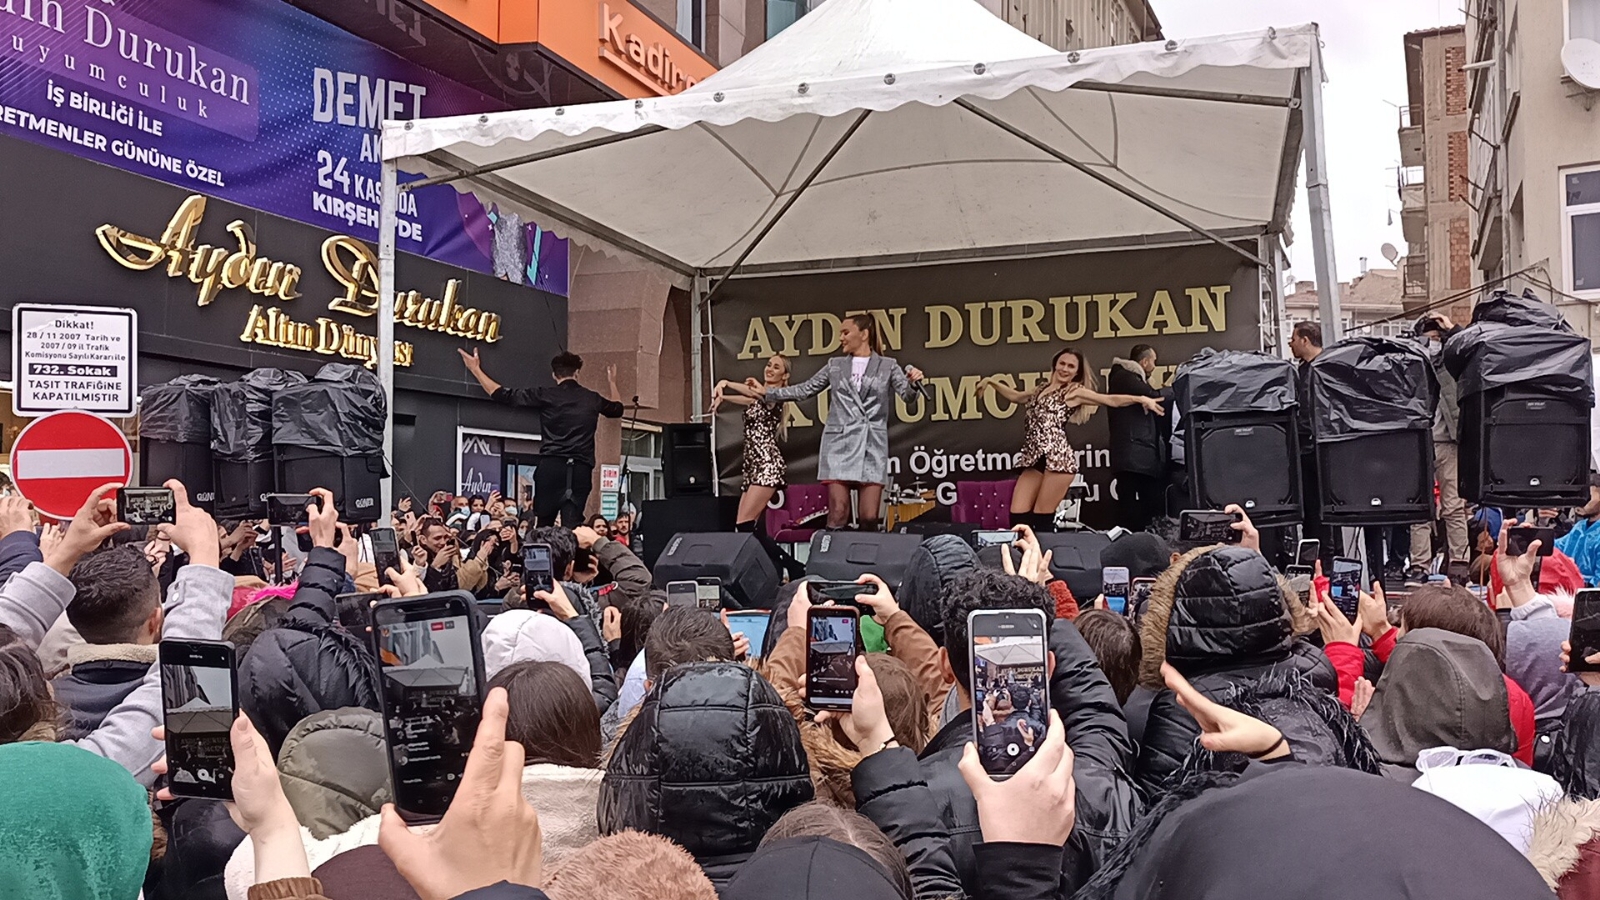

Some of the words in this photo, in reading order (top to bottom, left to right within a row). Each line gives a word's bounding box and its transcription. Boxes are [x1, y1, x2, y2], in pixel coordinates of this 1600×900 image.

[84, 4, 250, 105] Durukan
[47, 79, 65, 108] İŞ
[69, 91, 134, 127] BİRLİĞİ
[138, 110, 163, 137] İLE
[313, 67, 426, 131] DEMET
[111, 139, 183, 175] GÜNÜNE
[185, 158, 225, 187] ÖZEL
[317, 150, 351, 195] 24
[26, 331, 38, 339] 28
[46, 332, 57, 340] 11
[59, 332, 81, 341] 2007
[85, 333, 109, 342] Tarih
[55, 319, 94, 330] Dikkat!
[241, 304, 313, 351] Altın
[314, 317, 416, 370] Dünysı
[737, 307, 907, 360] AYDN
[925, 285, 1231, 348] DURUKAN
[24, 350, 67, 360] Komisyonu
[40, 341, 60, 350] 2007
[67, 342, 77, 350] 09
[86, 343, 110, 351] Trafik
[28, 379, 61, 390] TAŞIT
[32, 364, 64, 375] 732.
[67, 365, 112, 377] Sokak
[33, 391, 119, 403] KAPATILMIŞTIR
